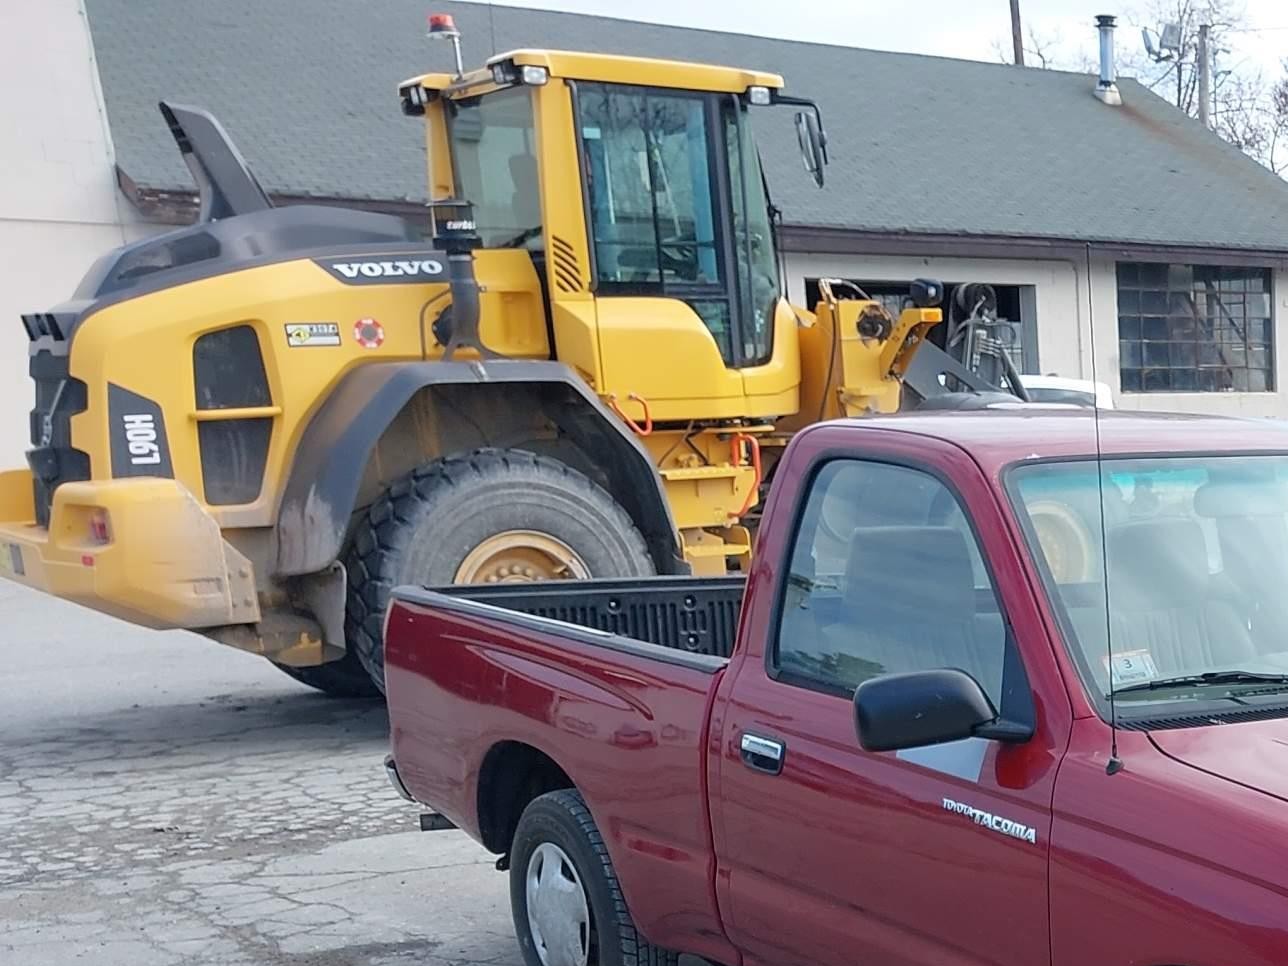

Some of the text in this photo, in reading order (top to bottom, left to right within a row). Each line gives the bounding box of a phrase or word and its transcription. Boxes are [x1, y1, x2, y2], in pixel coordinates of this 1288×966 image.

[332, 260, 443, 278] VOLVO
[123, 414, 161, 465] L90H
[1123, 658, 1133, 669] 3
[943, 798, 1036, 844] TOYOTA TACOMA
